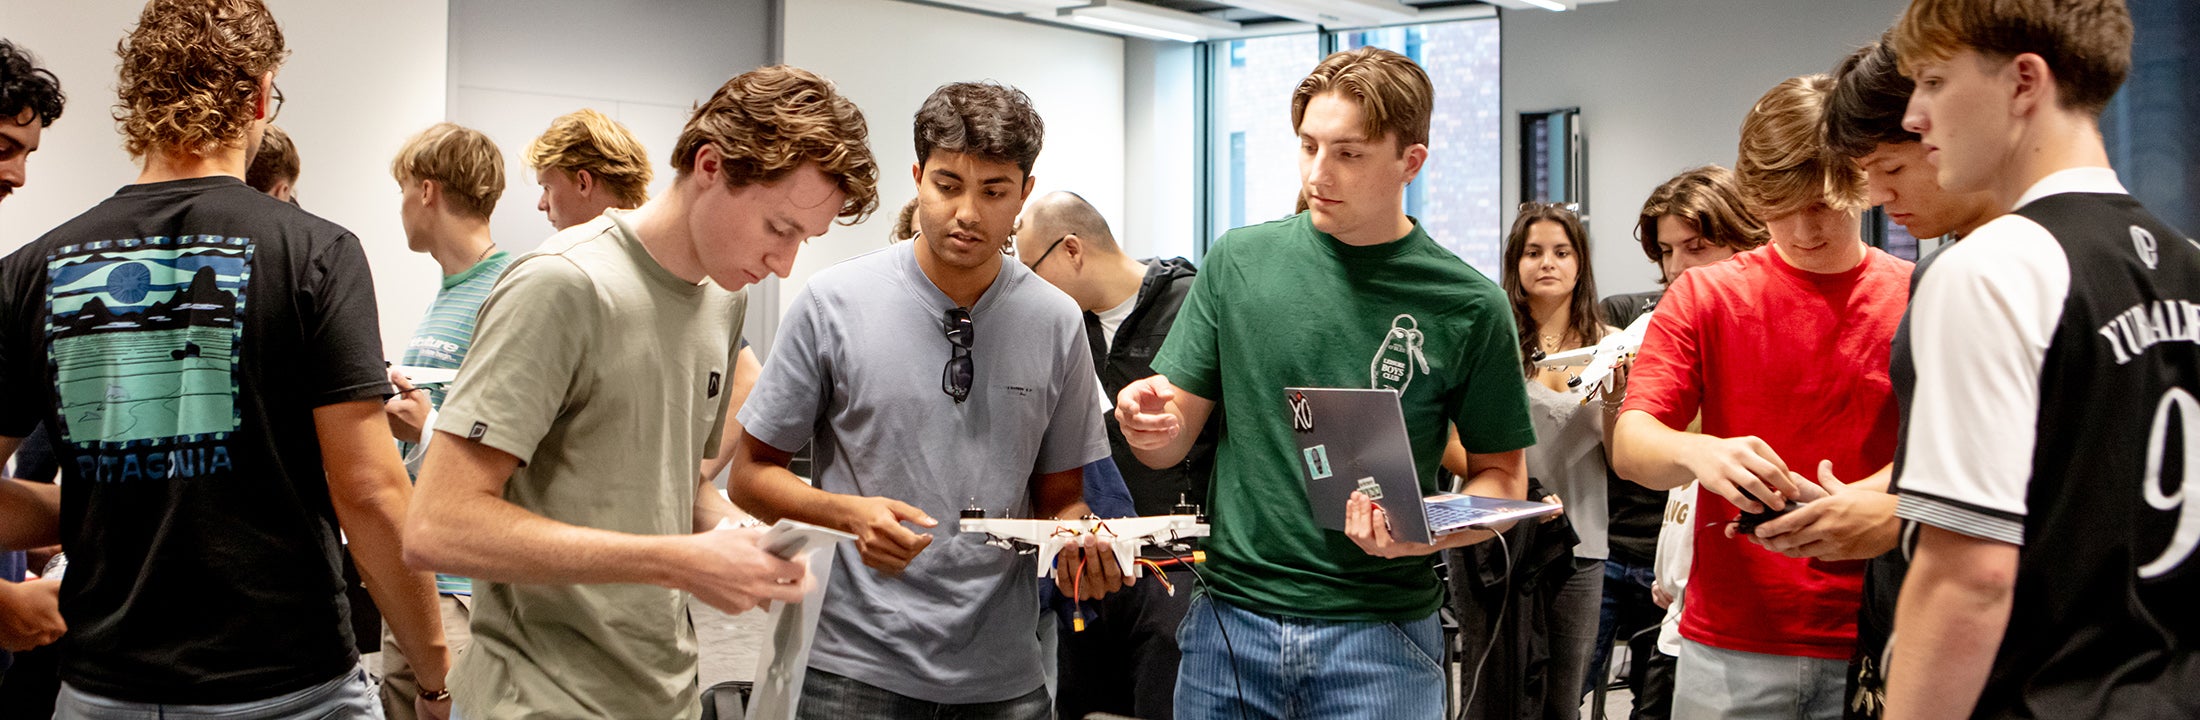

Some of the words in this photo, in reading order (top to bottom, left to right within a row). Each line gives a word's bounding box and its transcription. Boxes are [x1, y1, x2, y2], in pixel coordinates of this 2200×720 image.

[1381, 364, 1405, 377] BOYS
[1382, 372, 1400, 382] CLUB
[1288, 397, 1313, 430] XO
[76, 446, 232, 483] PTAGONIA
[2137, 386, 2200, 579] 9
